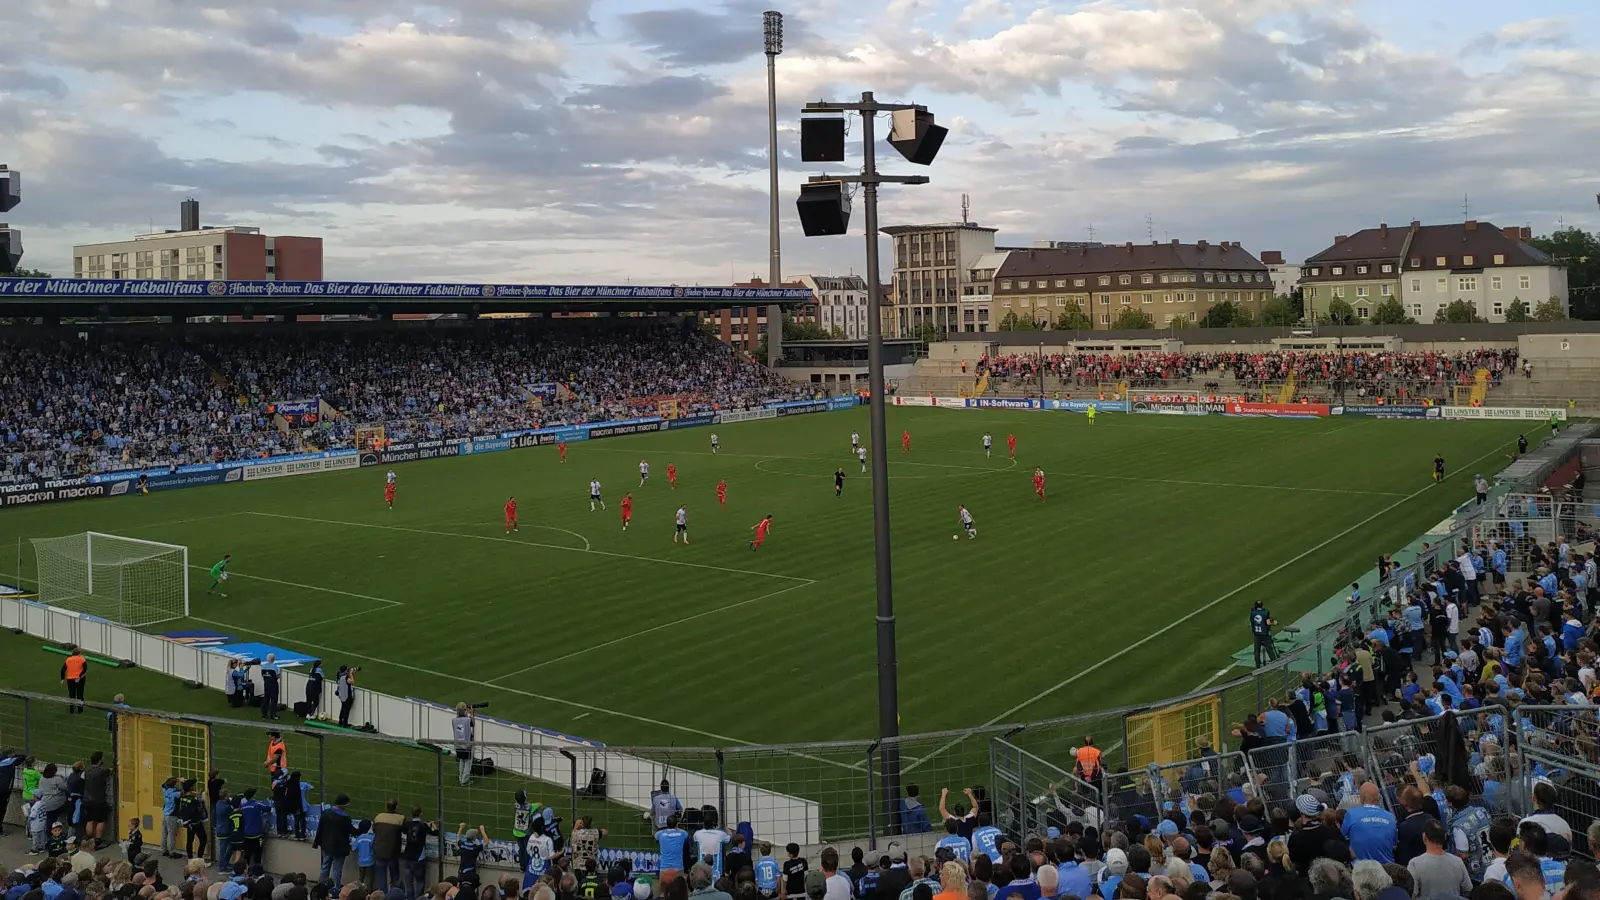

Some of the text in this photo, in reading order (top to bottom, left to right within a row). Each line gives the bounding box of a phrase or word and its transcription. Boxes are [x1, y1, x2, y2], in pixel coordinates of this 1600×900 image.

[14, 280, 41, 293] der
[45, 280, 120, 293] Münchner
[122, 281, 203, 296] Fußballfans
[303, 283, 324, 294] Das
[327, 283, 349, 294] Bier
[351, 283, 368, 295] der
[372, 283, 423, 295] Münchner
[424, 284, 480, 297] Fußballfans
[549, 286, 563, 296] Das
[564, 286, 580, 296] Bier
[581, 287, 596, 296] der
[597, 286, 631, 296] Münchner
[632, 287, 672, 297] Fußballfans
[721, 288, 732, 297] Das
[733, 288, 744, 297] Bier
[980, 399, 1029, 408] IN-Software
[1150, 403, 1185, 411] München
[1205, 404, 1225, 412] MAN
[591, 428, 614, 437] macron
[614, 425, 636, 434] macron
[637, 423, 658, 432] macron
[388, 443, 415, 452] macron
[417, 440, 443, 448] macron
[473, 434, 497, 442] macron
[474, 440, 510, 451] die Bayerisc
[510, 435, 538, 448] 3. LIGA
[381, 445, 458, 463] München fährt MAN
[295, 461, 321, 470] LINSTER
[332, 456, 357, 464] LINSTER
[256, 465, 283, 474] LINSTER
[187, 474, 220, 485] Arbeitgeber
[7, 491, 55, 505] macron
[59, 485, 104, 499] macron
[761, 866, 773, 880] 18
